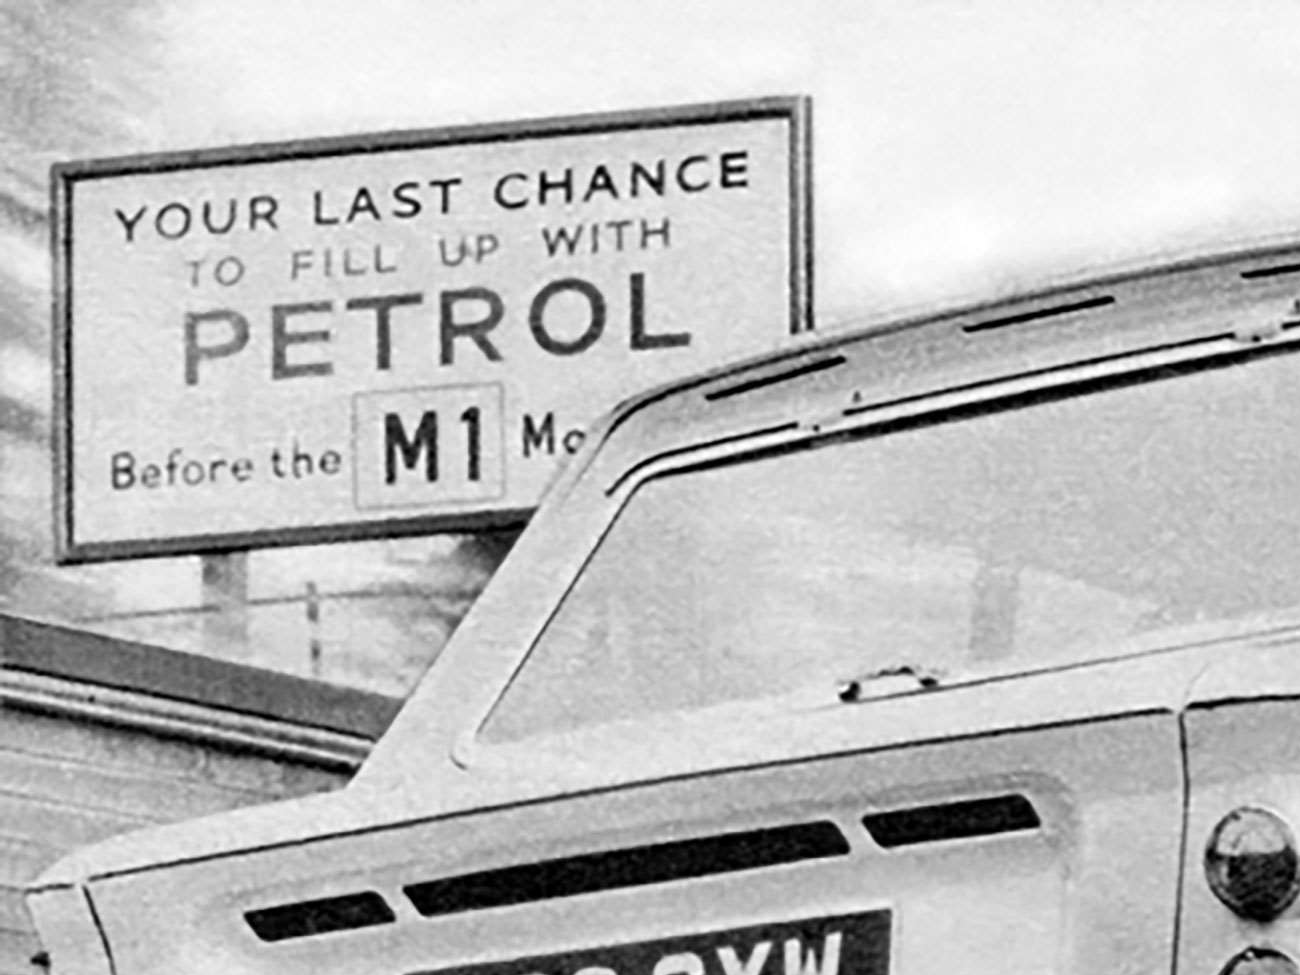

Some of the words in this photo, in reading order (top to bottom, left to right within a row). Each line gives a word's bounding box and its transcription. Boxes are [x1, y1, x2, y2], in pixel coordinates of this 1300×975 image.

[113, 195, 279, 243] YOUR
[312, 177, 464, 226] LAST
[492, 150, 750, 211] CHANCE
[187, 254, 246, 288] TO
[291, 244, 399, 282] FILL
[438, 233, 501, 268] UP
[540, 218, 672, 258] WITH
[183, 271, 693, 387] PETROL
[110, 448, 255, 491] Before
[270, 442, 343, 481] the
[384, 405, 481, 486] M1
